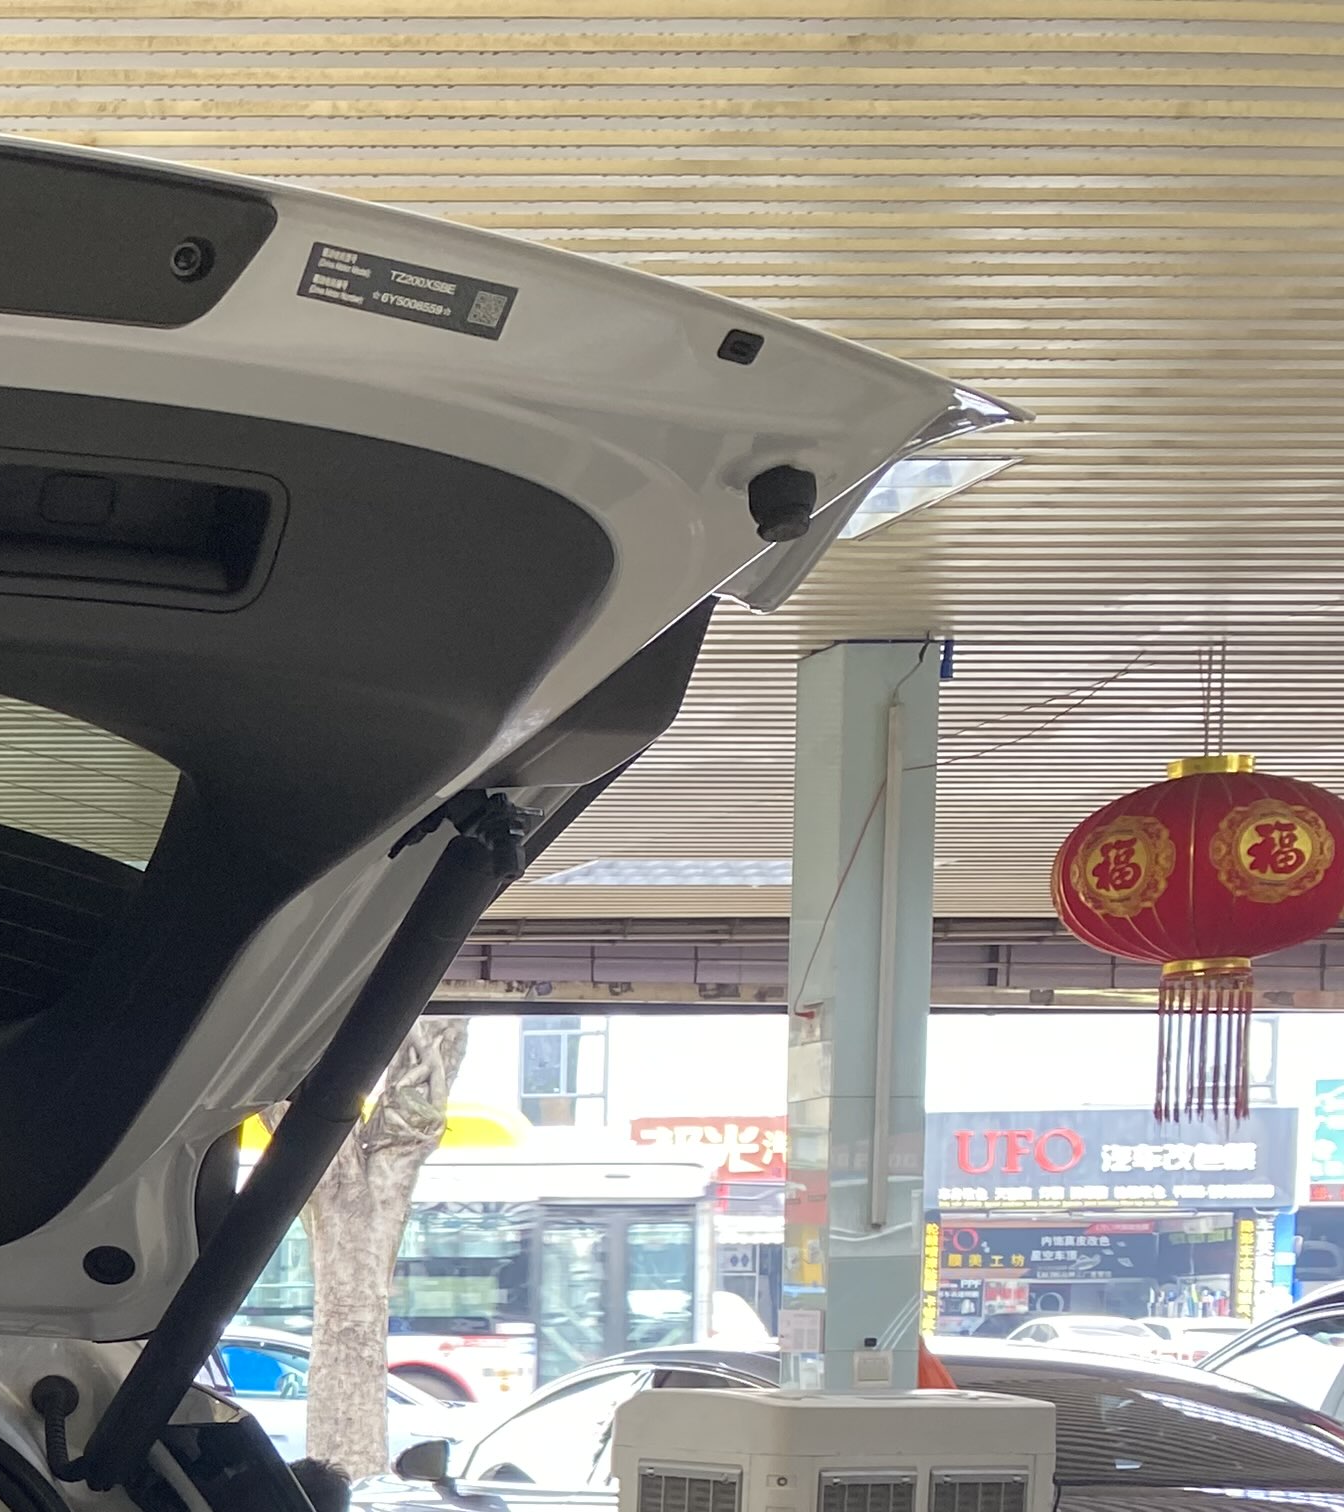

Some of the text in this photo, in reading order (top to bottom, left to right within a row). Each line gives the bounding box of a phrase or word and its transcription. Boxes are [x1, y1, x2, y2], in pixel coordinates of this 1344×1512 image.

[1092, 837, 1142, 891] 福
[1247, 820, 1306, 873] 福
[954, 1127, 1085, 1175] UFO
